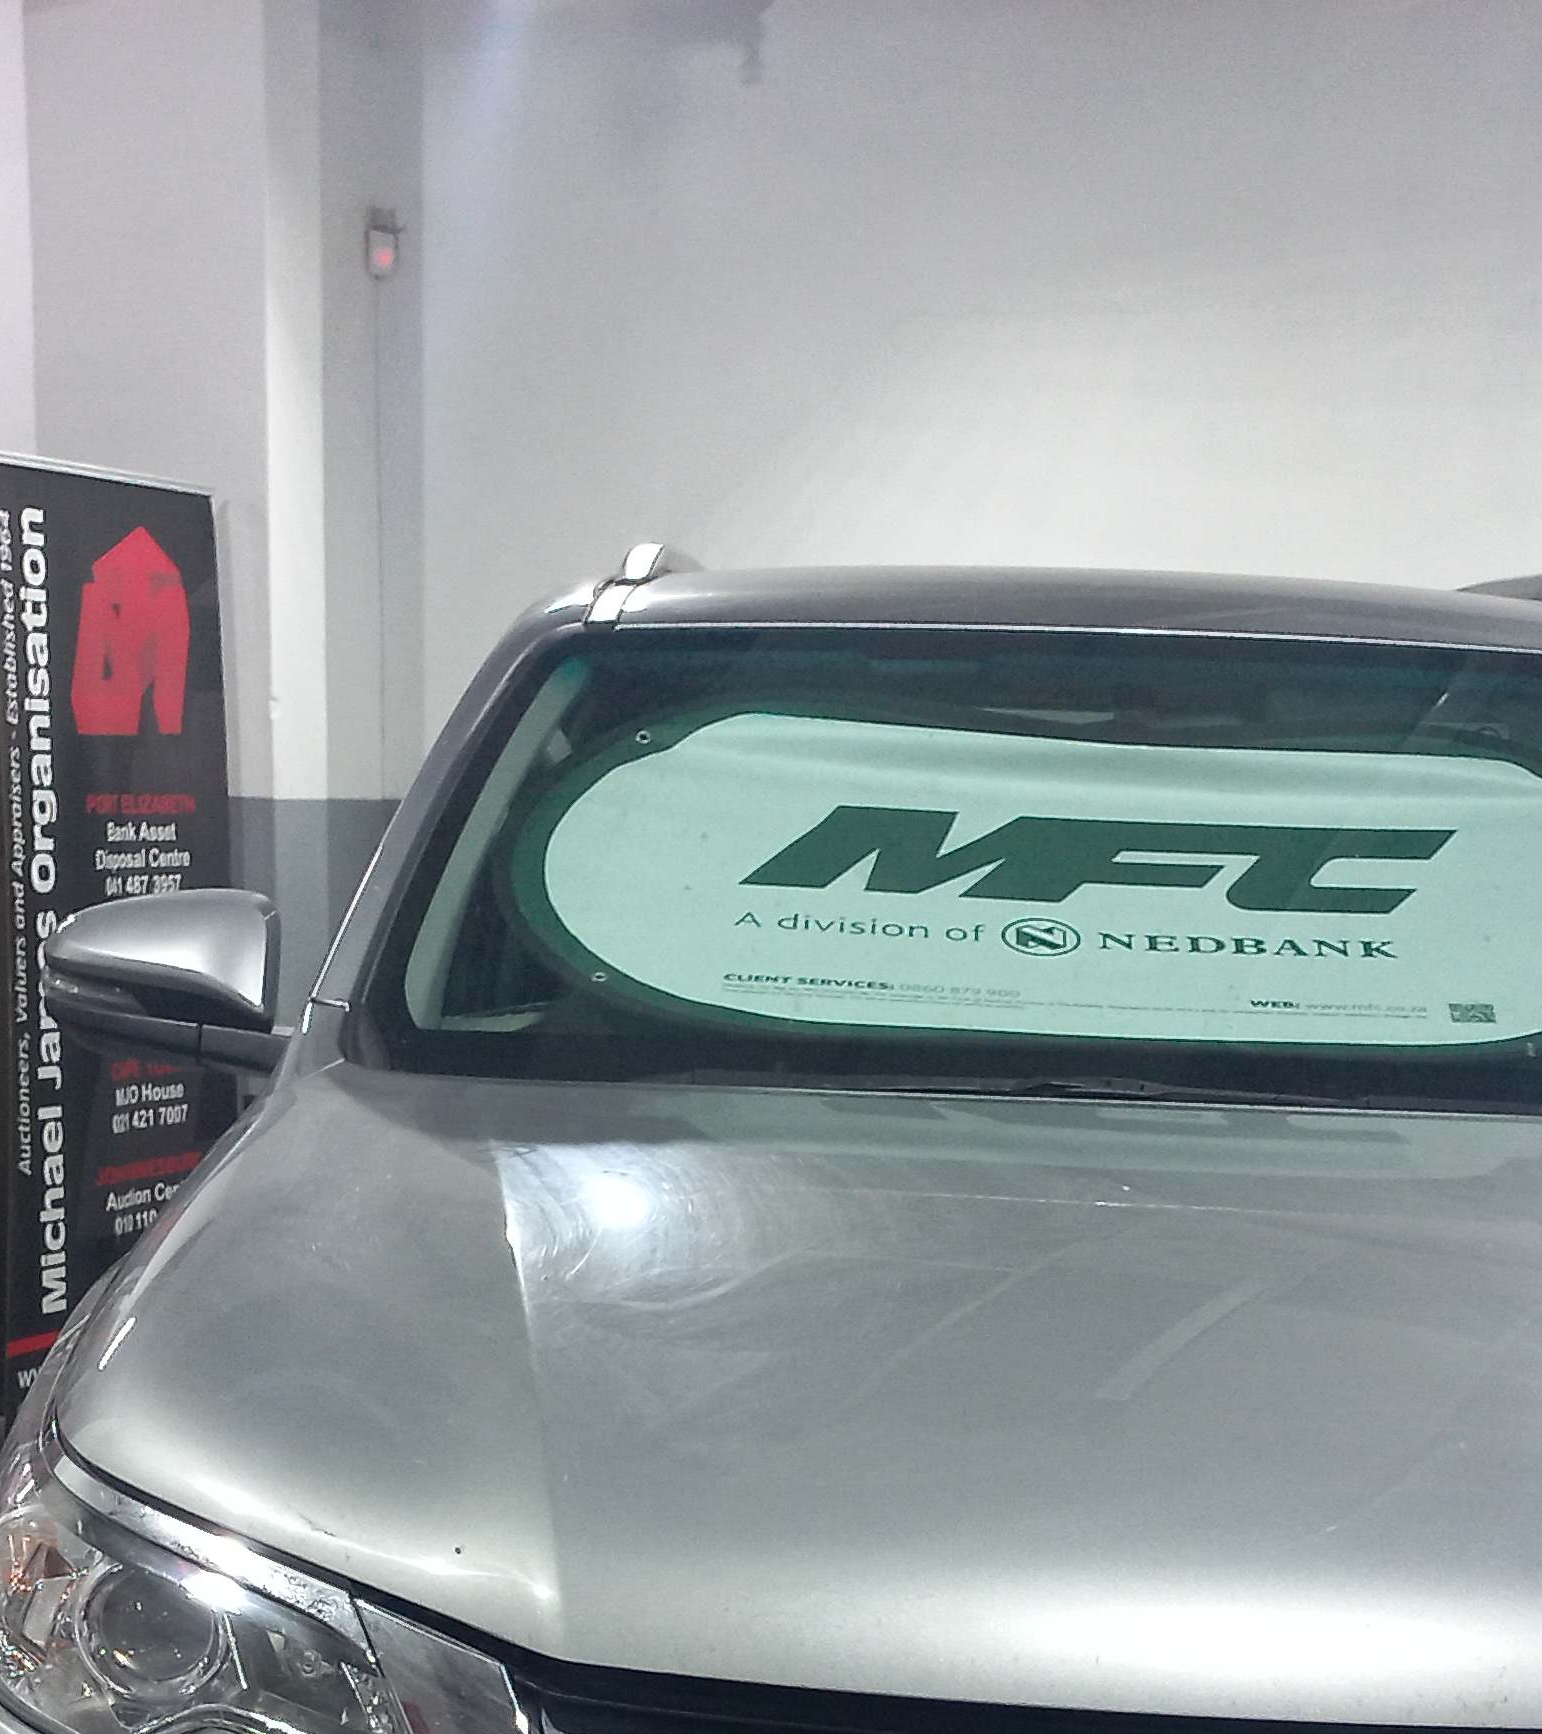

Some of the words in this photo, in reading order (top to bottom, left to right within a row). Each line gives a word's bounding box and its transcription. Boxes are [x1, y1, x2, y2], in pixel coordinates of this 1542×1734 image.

[18, 507, 58, 894] Organisation
[739, 805, 1458, 914] MFC
[723, 973, 791, 984] CLIENT
[734, 912, 761, 928] A
[777, 914, 929, 938] division
[946, 925, 986, 941] of
[1099, 932, 1398, 958] NEDBANK
[37, 1105, 68, 1314] Michael
